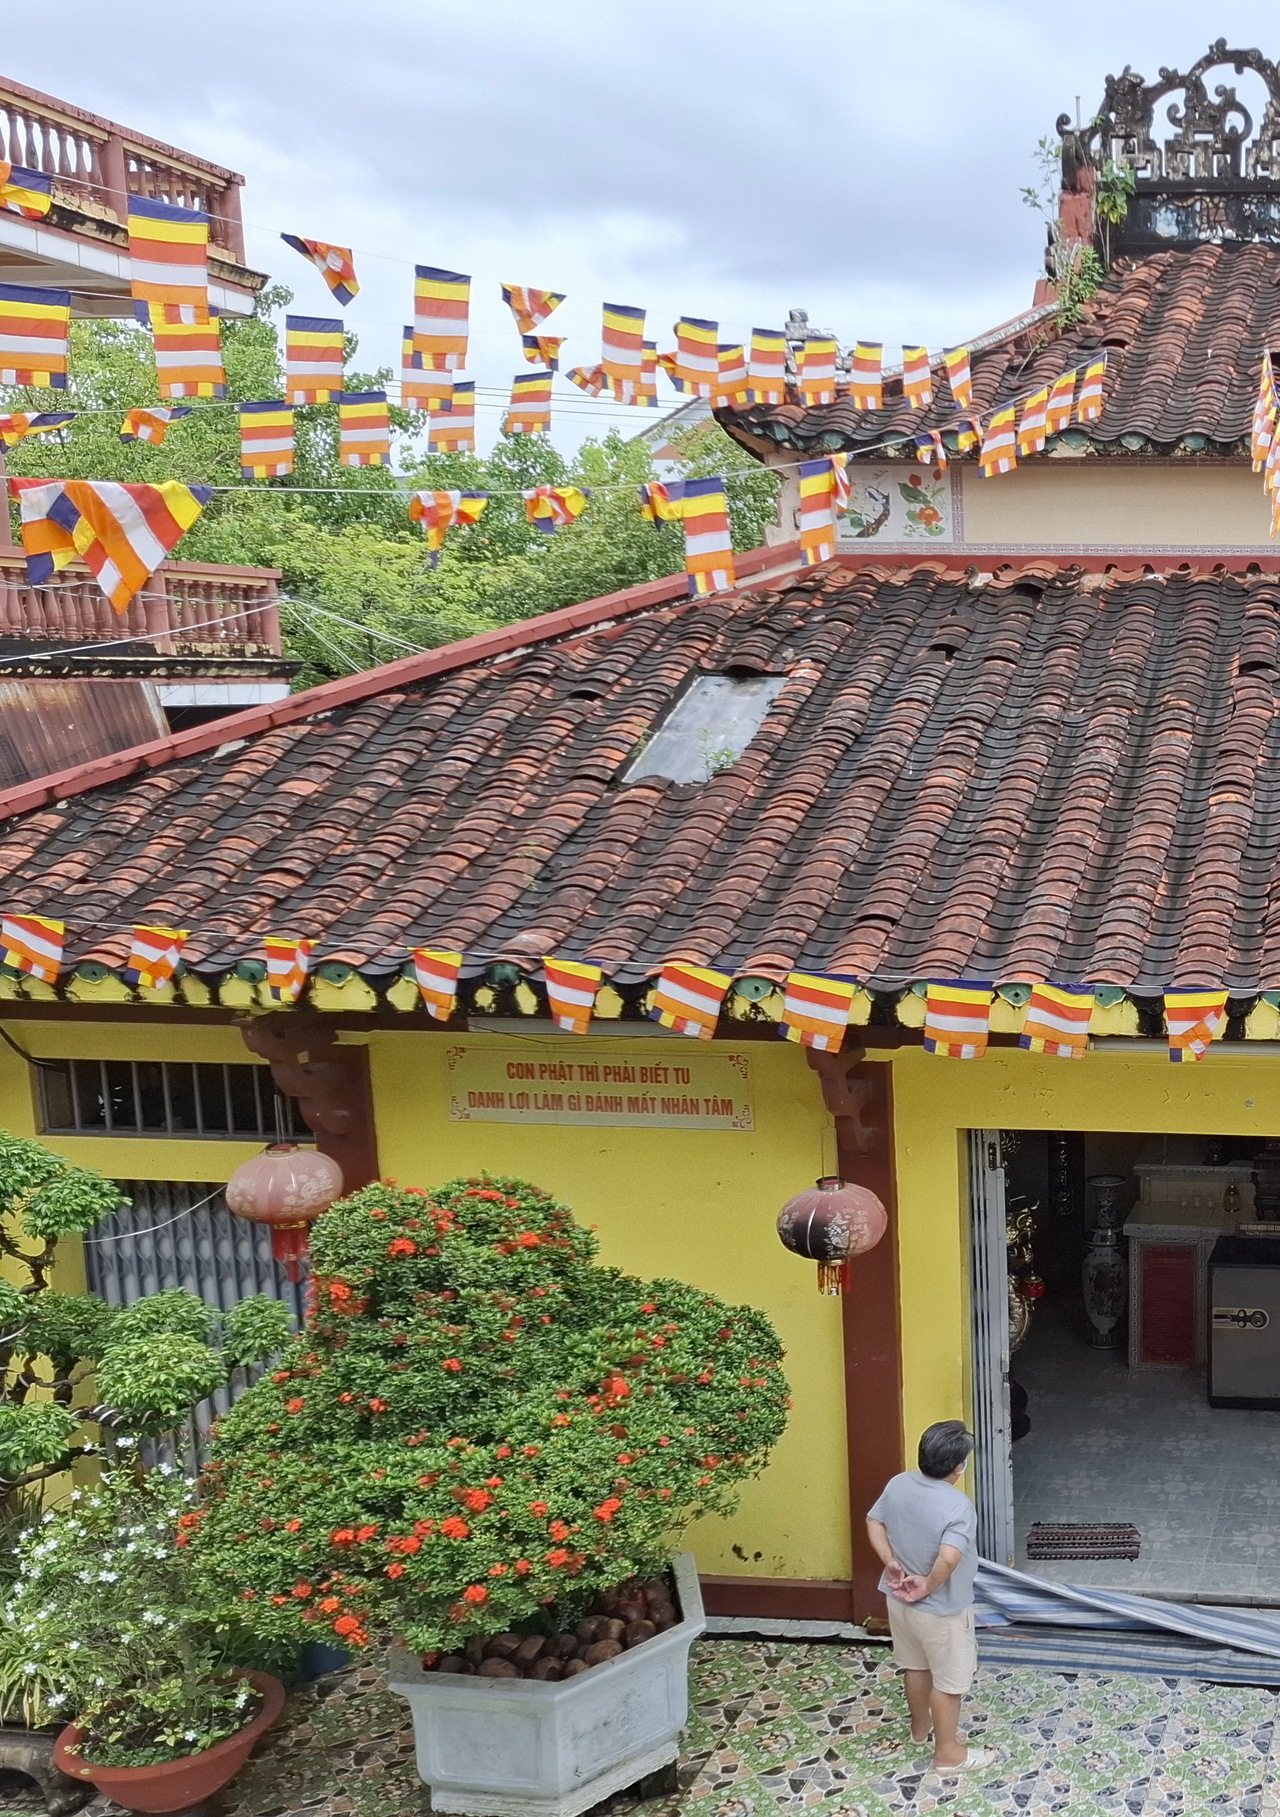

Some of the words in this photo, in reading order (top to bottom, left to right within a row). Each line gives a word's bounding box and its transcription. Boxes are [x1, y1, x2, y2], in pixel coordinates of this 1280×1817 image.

[506, 1062, 535, 1080] CON
[539, 1060, 574, 1085] PHẬT
[577, 1061, 599, 1082] THÌ
[603, 1060, 636, 1083] PHẢI
[640, 1061, 669, 1084] BIẾT
[673, 1067, 691, 1084] TU
[467, 1091, 505, 1109] DANH
[508, 1091, 530, 1113] LỢI
[533, 1089, 563, 1111] LÀM
[567, 1090, 581, 1111] GÌ
[627, 1090, 657, 1114] MẤT
[661, 1094, 700, 1115] NHÂN
[703, 1094, 733, 1116] TÂM
